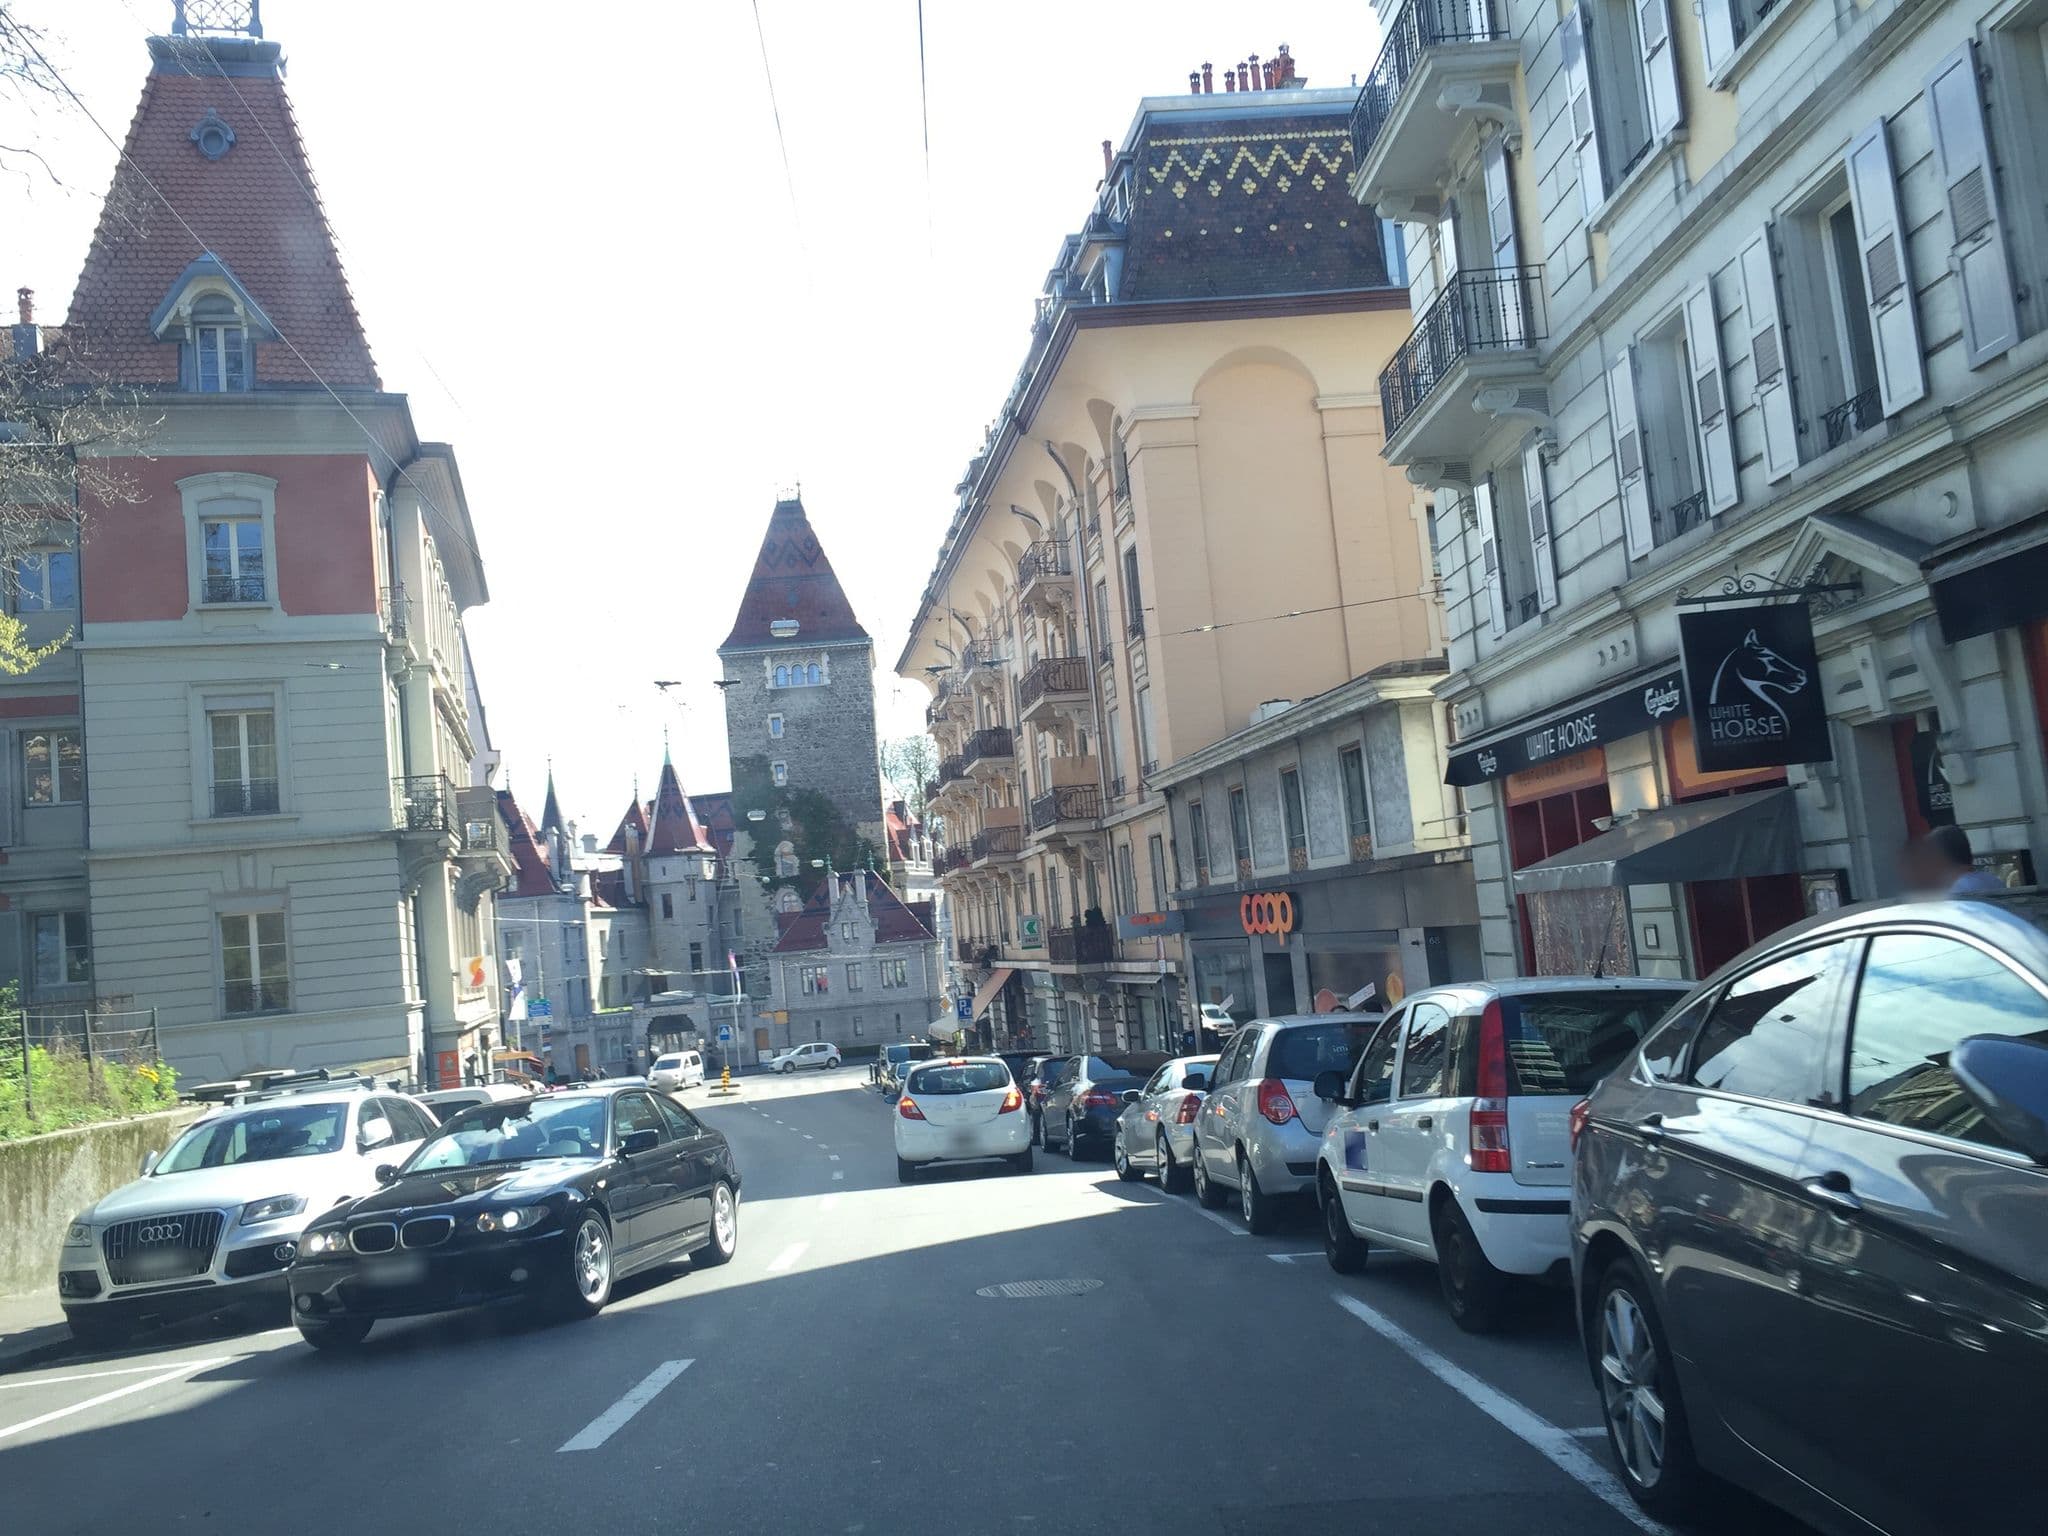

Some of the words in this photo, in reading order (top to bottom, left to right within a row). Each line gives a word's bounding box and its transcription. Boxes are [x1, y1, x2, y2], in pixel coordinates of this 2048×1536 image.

[1709, 703, 1751, 719] WHITE
[1710, 715, 1783, 739] HORSE
[1526, 728, 1556, 761] WHITE
[1558, 713, 1598, 752] HORSE
[1240, 892, 1293, 947] coop
